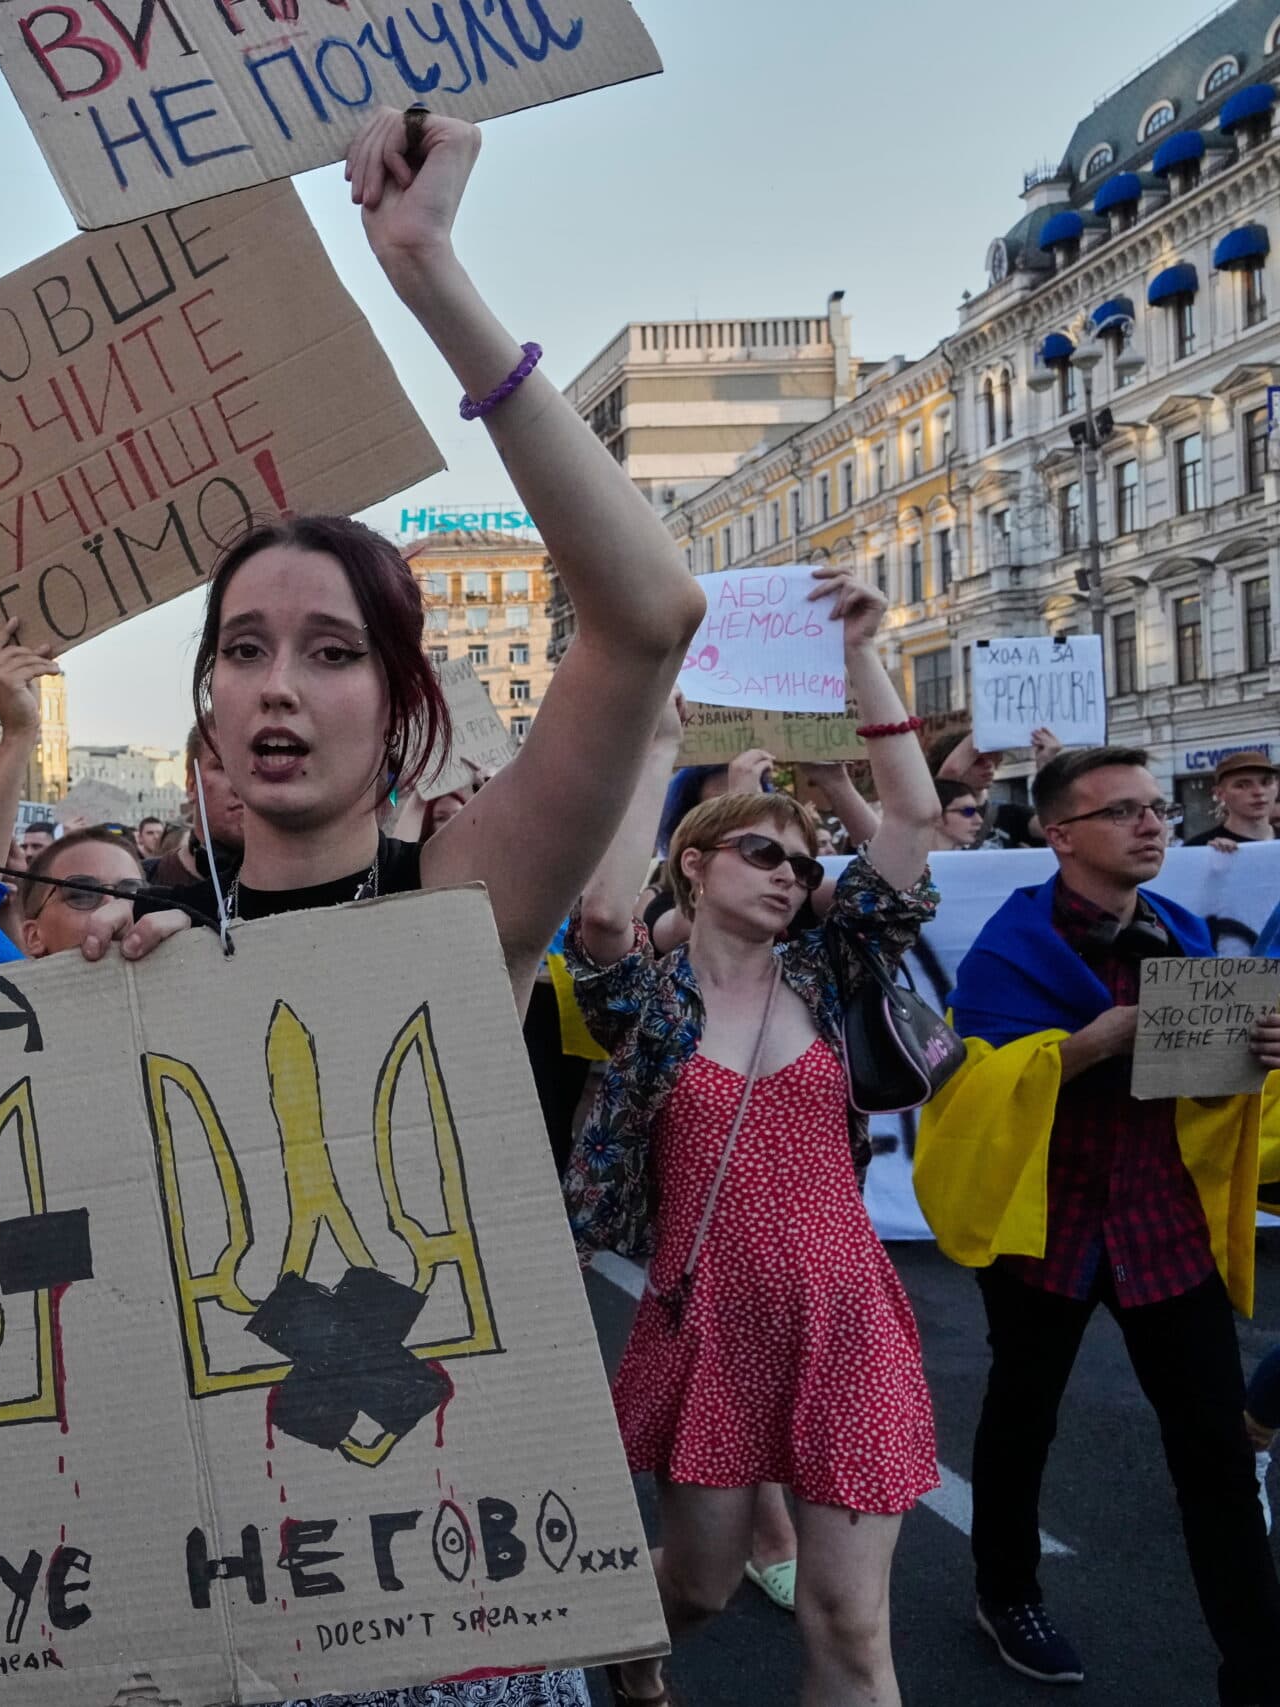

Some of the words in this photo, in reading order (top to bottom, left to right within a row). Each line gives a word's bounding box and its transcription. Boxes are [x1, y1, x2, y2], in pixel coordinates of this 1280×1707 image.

[87, 79, 253, 191] НЕ
[719, 575, 788, 609] АБО
[1144, 960, 1158, 985] Я
[1188, 980, 1238, 1001] ТИХ
[1142, 1005, 1184, 1028] ХТО
[1187, 1001, 1255, 1026] СТОЇТЬ
[1154, 1027, 1214, 1049] МЕНЕ
[185, 1518, 345, 1609] НЕ
